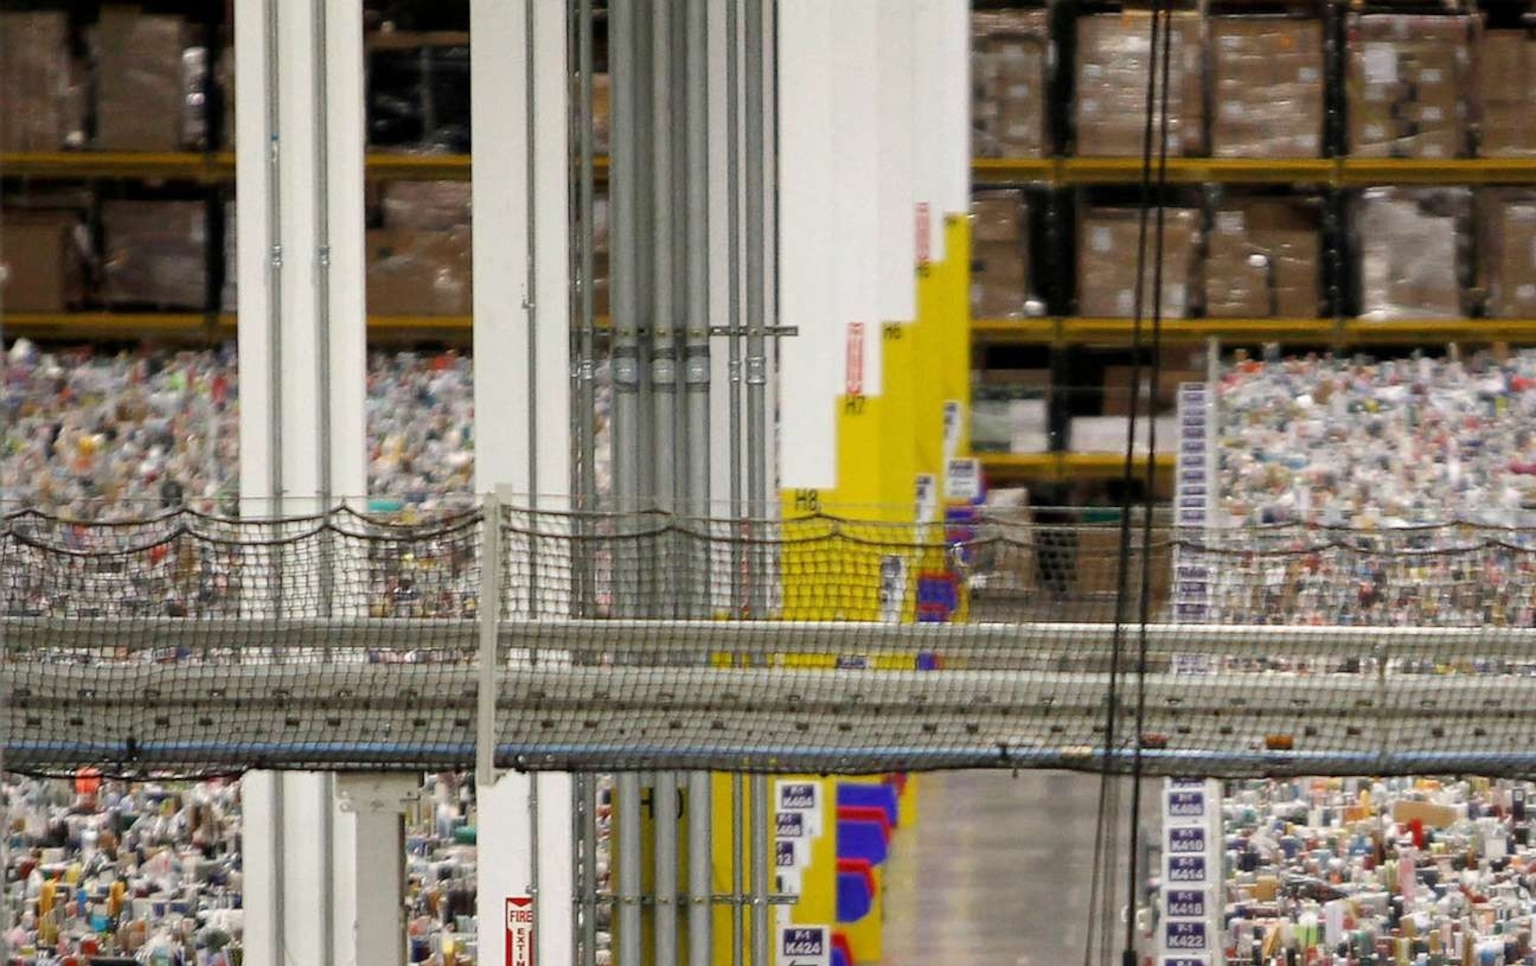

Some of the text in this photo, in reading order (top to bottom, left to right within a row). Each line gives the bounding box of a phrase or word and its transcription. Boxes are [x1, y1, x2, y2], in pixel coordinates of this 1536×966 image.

[846, 396, 865, 414] H7
[794, 488, 818, 512] H8
[510, 910, 533, 923] FIRE
[786, 942, 820, 954] K424
[1169, 935, 1203, 948] K422
